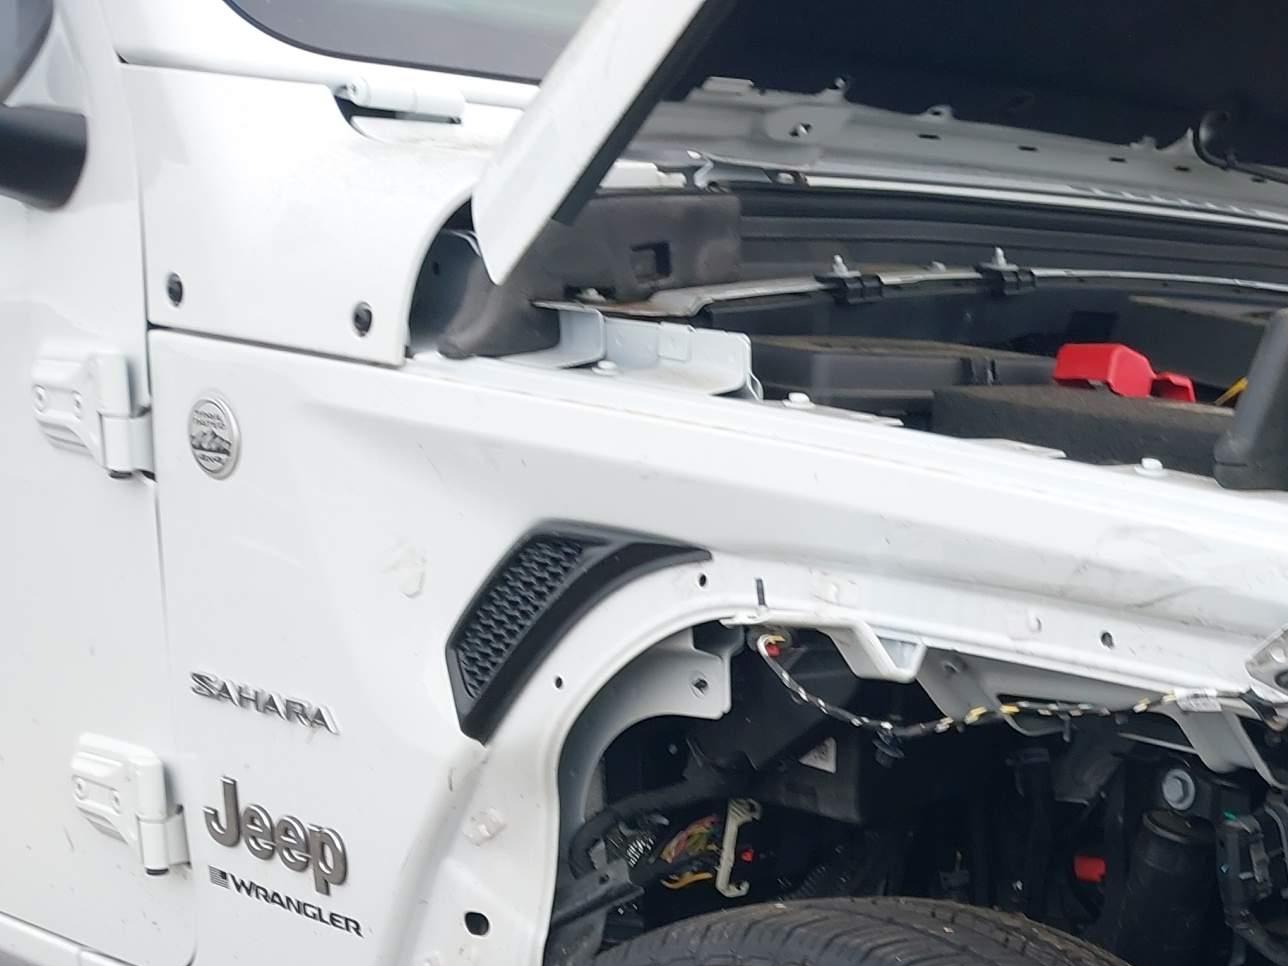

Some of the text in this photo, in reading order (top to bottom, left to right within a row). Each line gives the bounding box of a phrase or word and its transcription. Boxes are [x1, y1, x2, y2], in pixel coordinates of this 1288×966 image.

[191, 671, 340, 735] SAHARA
[202, 776, 347, 896] Jeep
[229, 873, 363, 938] WRANGLER
